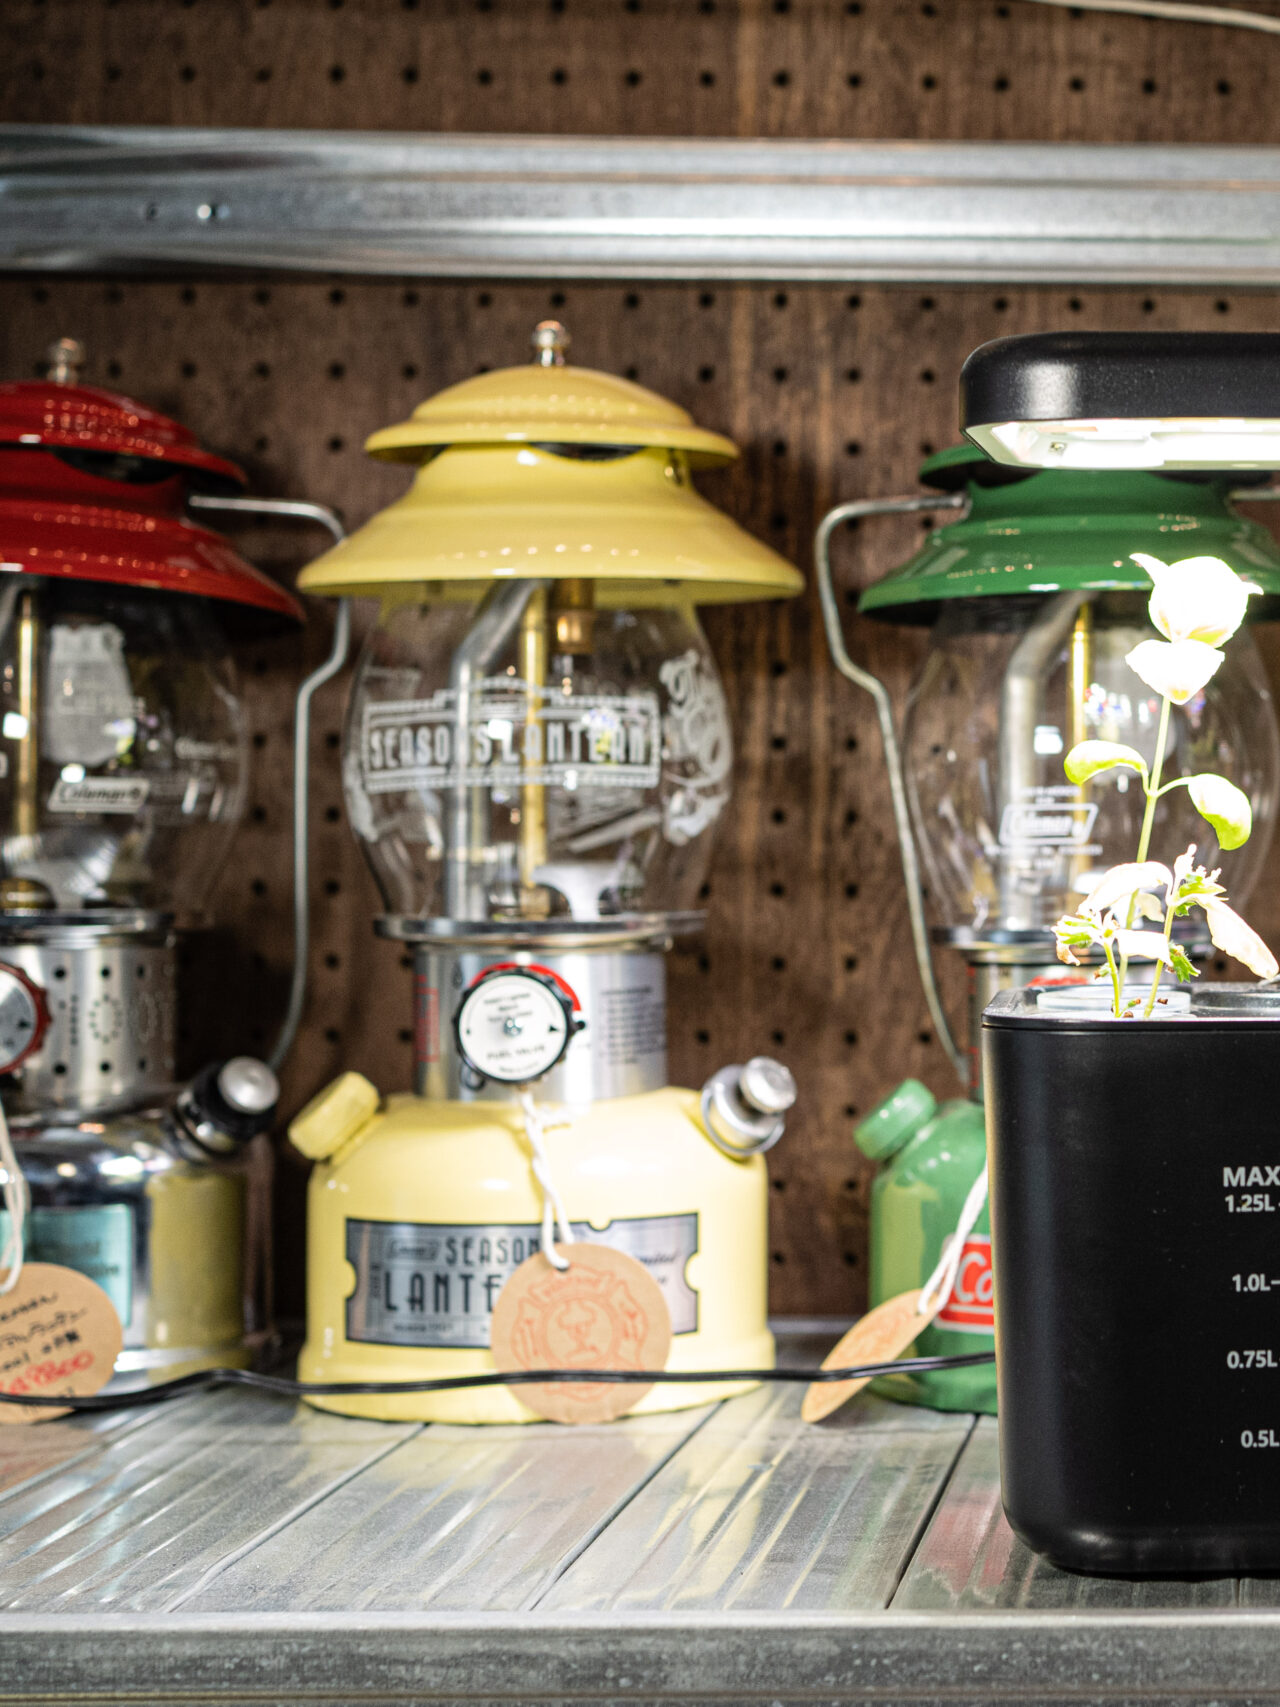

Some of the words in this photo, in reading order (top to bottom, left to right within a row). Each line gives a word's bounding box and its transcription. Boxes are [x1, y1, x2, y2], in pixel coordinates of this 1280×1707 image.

[370, 724, 492, 770] SEASOS
[1224, 1194, 1275, 1213] 1.25L
[446, 1236, 541, 1265] SEASON
[384, 1270, 503, 1314] LANTE
[1232, 1273, 1271, 1292] 1.0L
[1226, 1350, 1278, 1369] 0.75L
[1240, 1429, 1280, 1448] 0.5L
